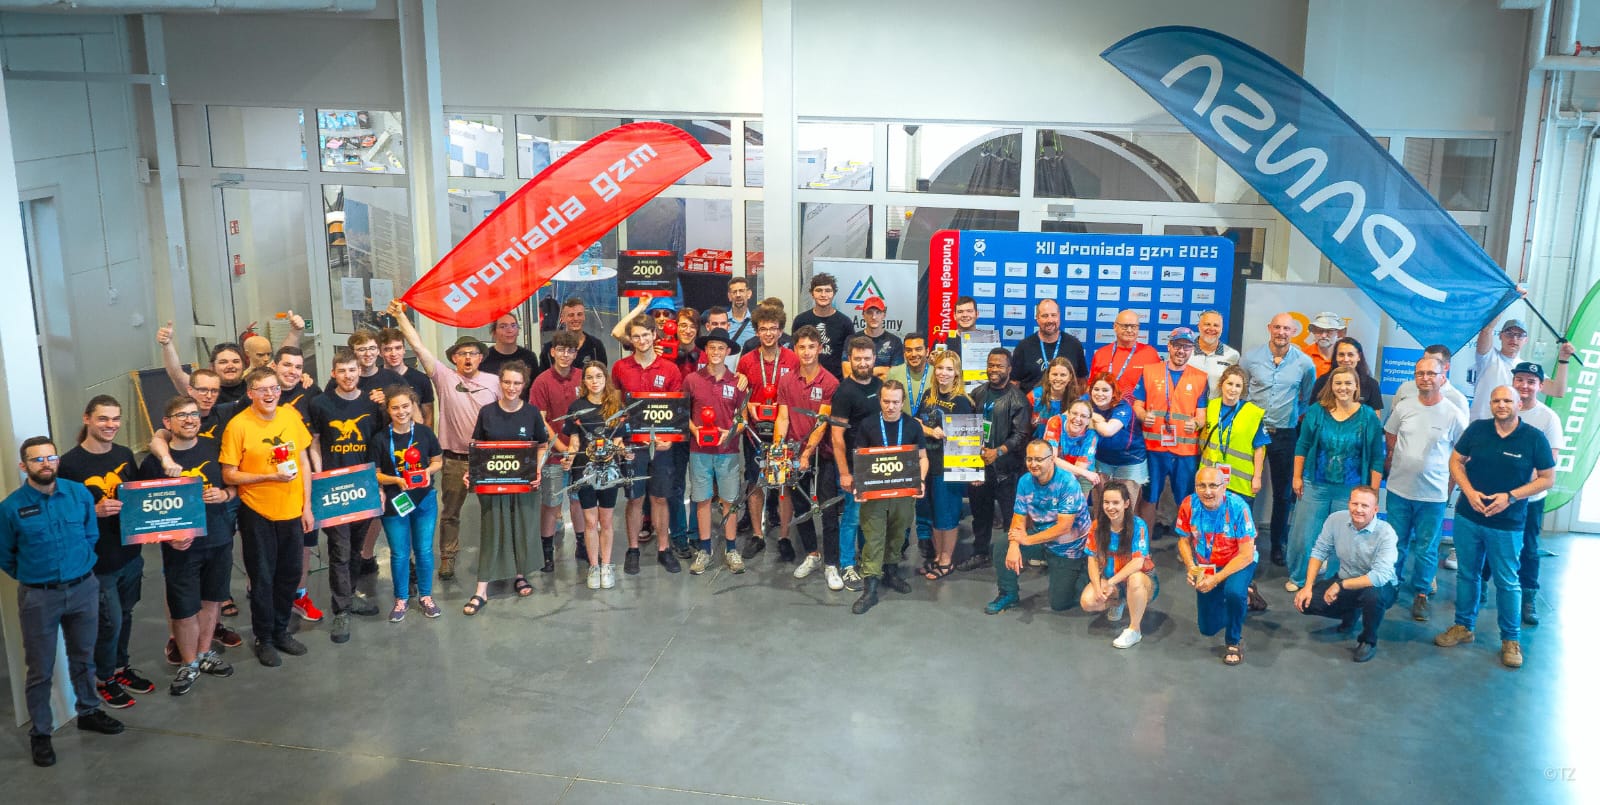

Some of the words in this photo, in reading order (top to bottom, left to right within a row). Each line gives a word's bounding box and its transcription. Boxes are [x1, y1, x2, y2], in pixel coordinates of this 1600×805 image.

[442, 195, 586, 313] droniada
[590, 143, 659, 202] gzm
[1036, 241, 1055, 255] XII
[1059, 242, 1135, 257] droniada
[1139, 246, 1174, 261] gzm
[1178, 246, 1218, 259] 2025
[632, 265, 663, 276] 2000
[940, 238, 954, 288] Fundacja
[853, 315, 903, 331] Acmy
[642, 409, 674, 420] 7000
[486, 460, 521, 471] 6000
[871, 461, 904, 474] 5000
[142, 497, 183, 512] 5000
[321, 488, 367, 506] 15000
